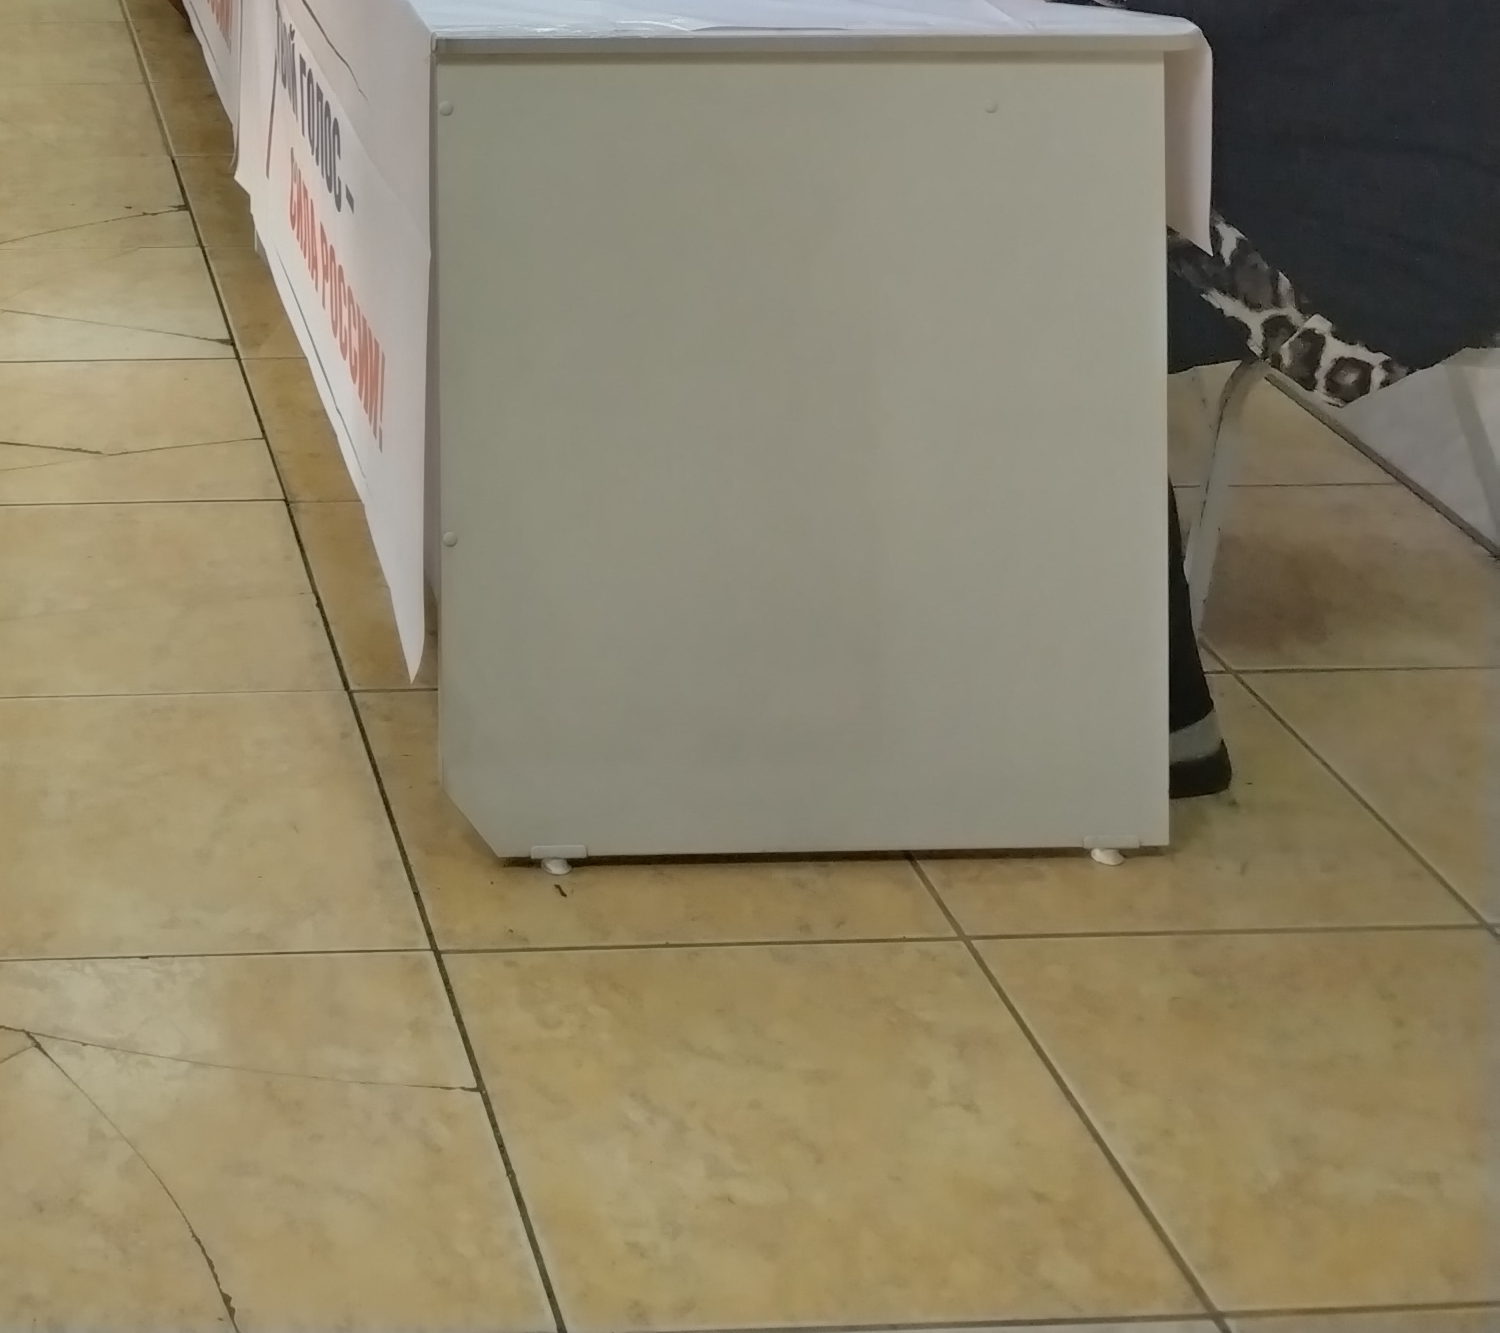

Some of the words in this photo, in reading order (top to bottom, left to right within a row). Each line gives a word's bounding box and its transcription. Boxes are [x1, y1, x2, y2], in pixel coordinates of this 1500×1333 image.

[299, 52, 343, 213] ГОЛОС
[289, 146, 319, 293] СИЛА
[320, 220, 386, 454] РОССИИ!
